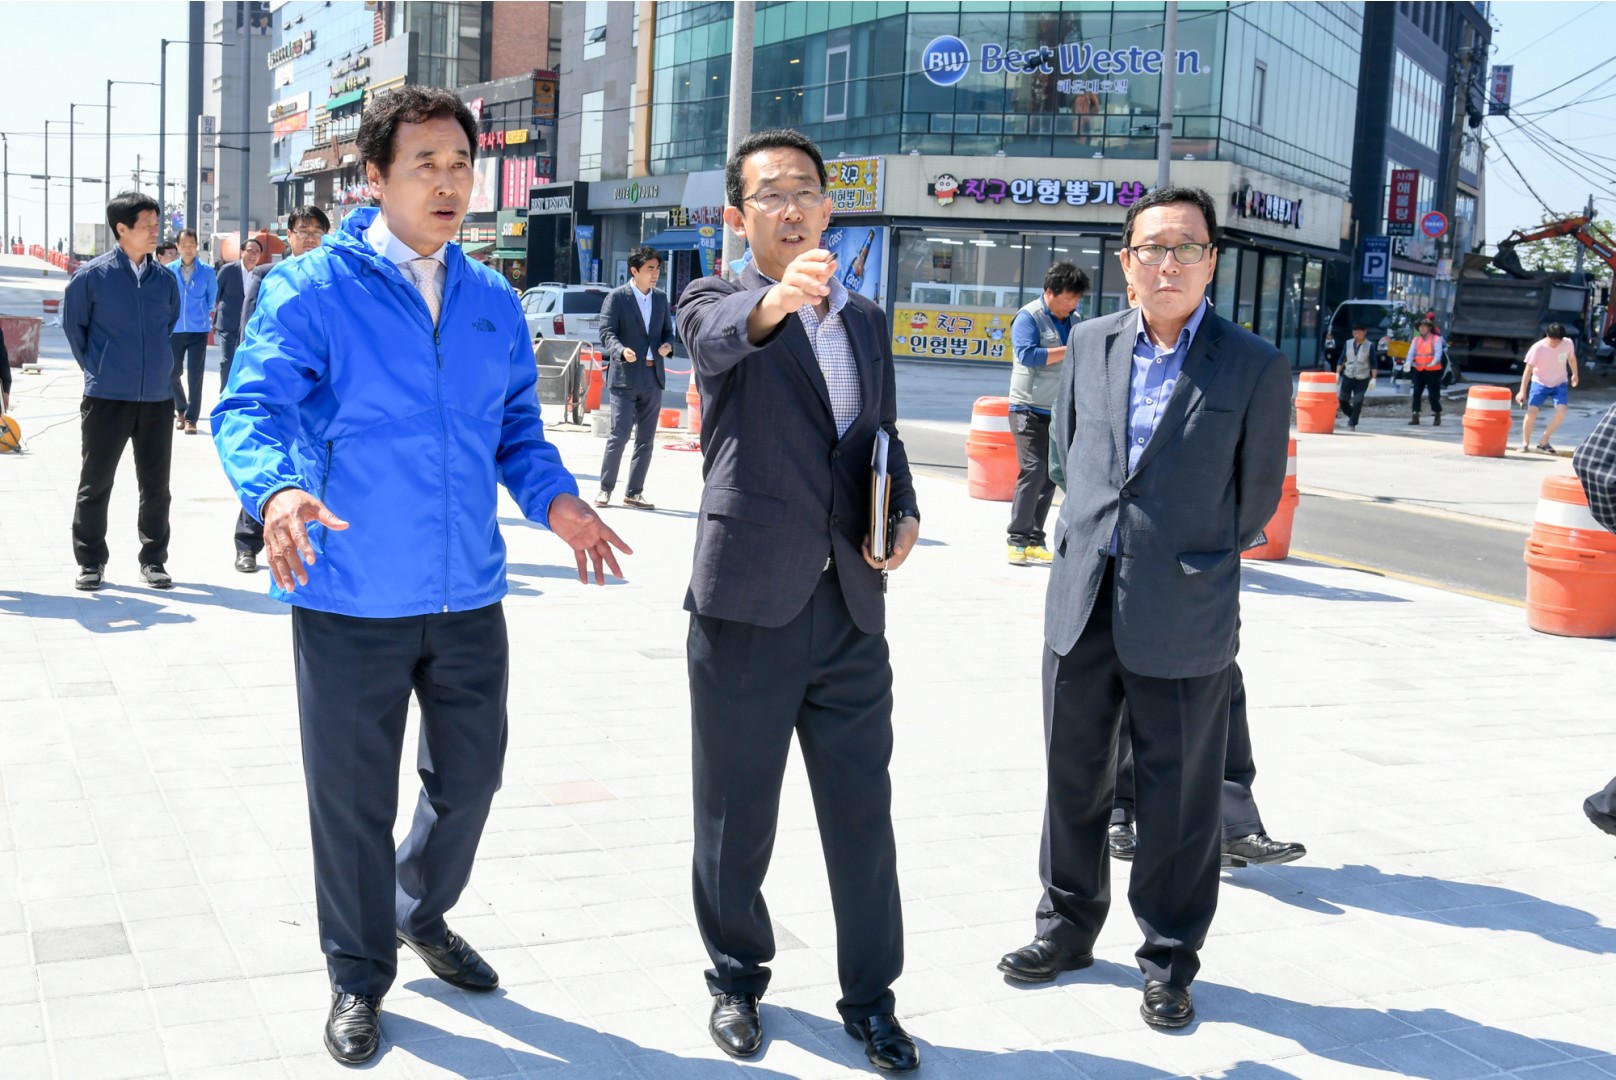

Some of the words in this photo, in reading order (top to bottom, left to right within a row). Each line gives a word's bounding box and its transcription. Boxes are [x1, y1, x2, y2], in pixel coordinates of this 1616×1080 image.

[928, 51, 964, 72] BW
[980, 43, 1054, 74] Best
[1058, 43, 1201, 75] Westen
[1057, 79, 1128, 94] 해운대호텔
[840, 162, 859, 185] 친구
[613, 187, 630, 201] OLIVE
[638, 184, 659, 199] YOUNG
[965, 178, 1006, 204] 친구
[1010, 178, 1144, 206] 인형뽑기샵
[828, 229, 843, 248] Cass
[1367, 256, 1384, 274] P
[936, 311, 974, 334] 친구
[909, 335, 1004, 357] 인형뽑기샵
